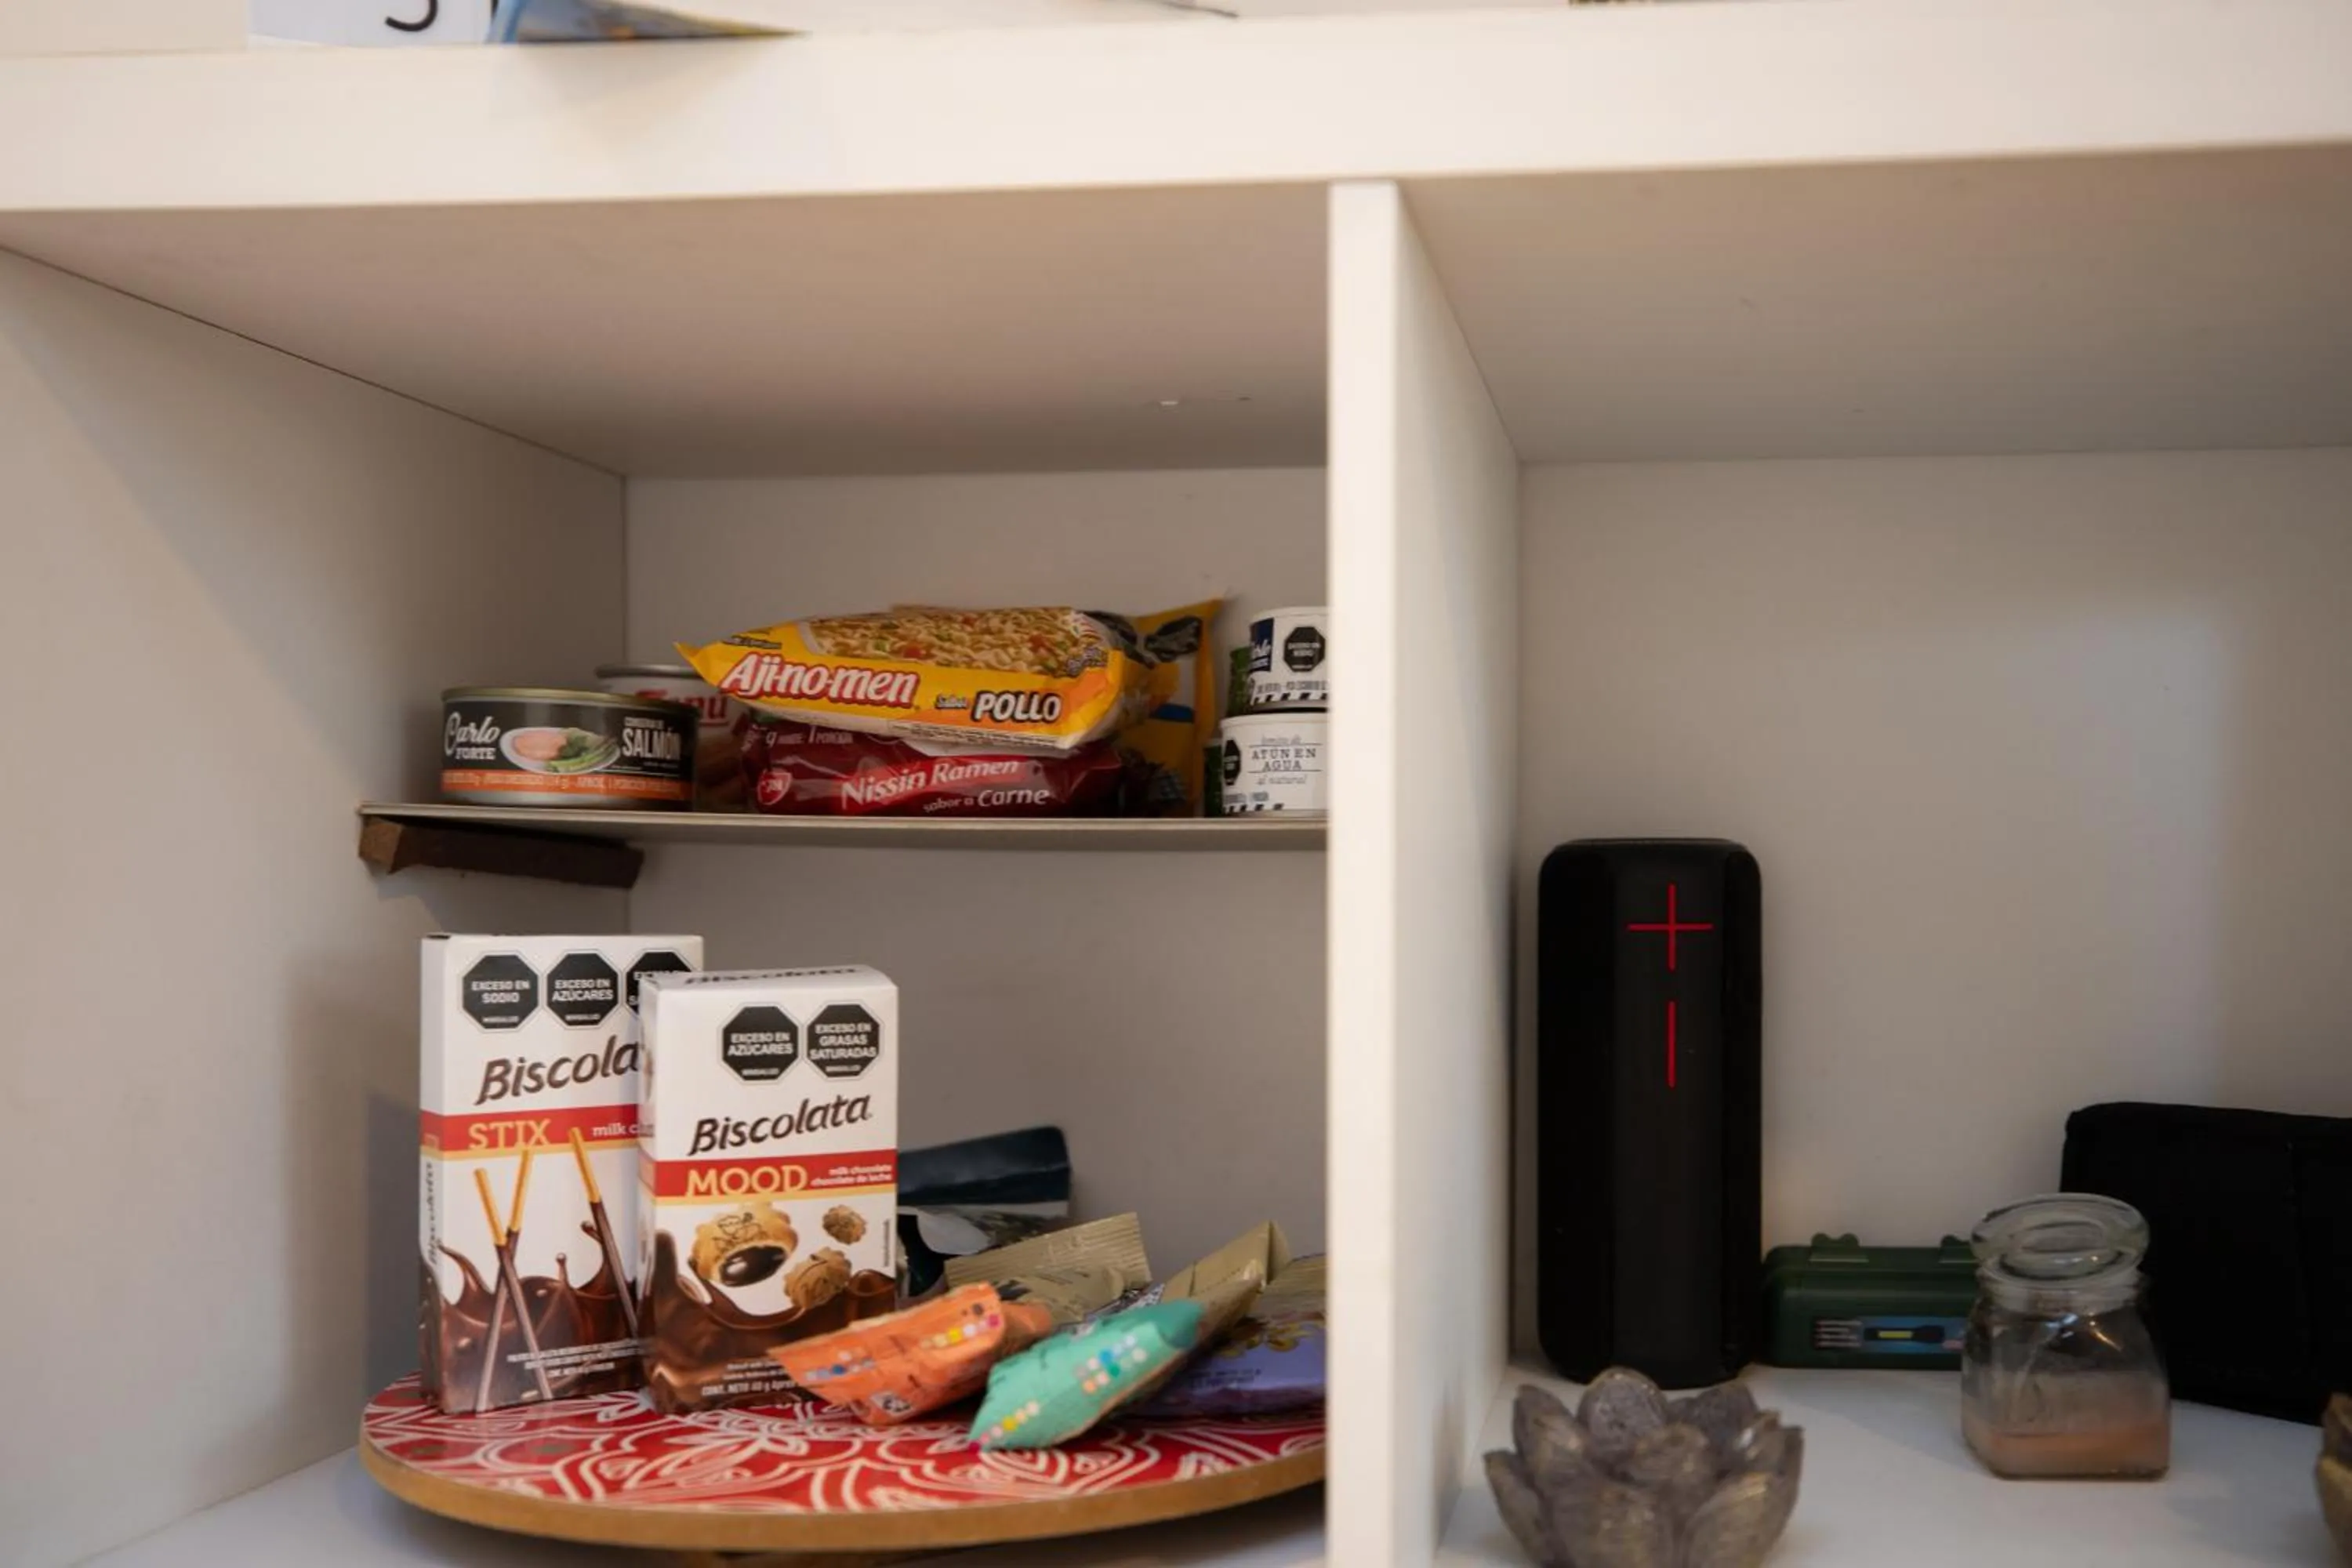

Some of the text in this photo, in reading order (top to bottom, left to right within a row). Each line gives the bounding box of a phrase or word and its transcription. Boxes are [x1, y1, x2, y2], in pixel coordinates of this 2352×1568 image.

[973, 691, 1062, 723] POLLO
[445, 712, 501, 756] Carlo
[455, 747, 496, 760] FORTE
[1294, 747, 1316, 758] EN
[1262, 760, 1302, 771] AGUA
[841, 760, 1018, 810] Nissin Ramen
[923, 789, 1050, 813] sabor a Carne
[472, 980, 530, 991] EXCESO EN
[555, 978, 611, 989] EXCESO EN
[482, 992, 520, 1004] SODIO
[815, 1022, 871, 1034] EXCESO EN
[731, 1032, 790, 1044] EXCESO EN
[818, 1034, 868, 1046] GRASAS
[809, 1047, 877, 1060] SATURADAS
[474, 1035, 639, 1105] Biscola
[687, 1094, 870, 1156] Biscolata
[468, 1119, 550, 1149] STIX
[593, 1123, 626, 1137] milk
[685, 1164, 808, 1197] MOOD
